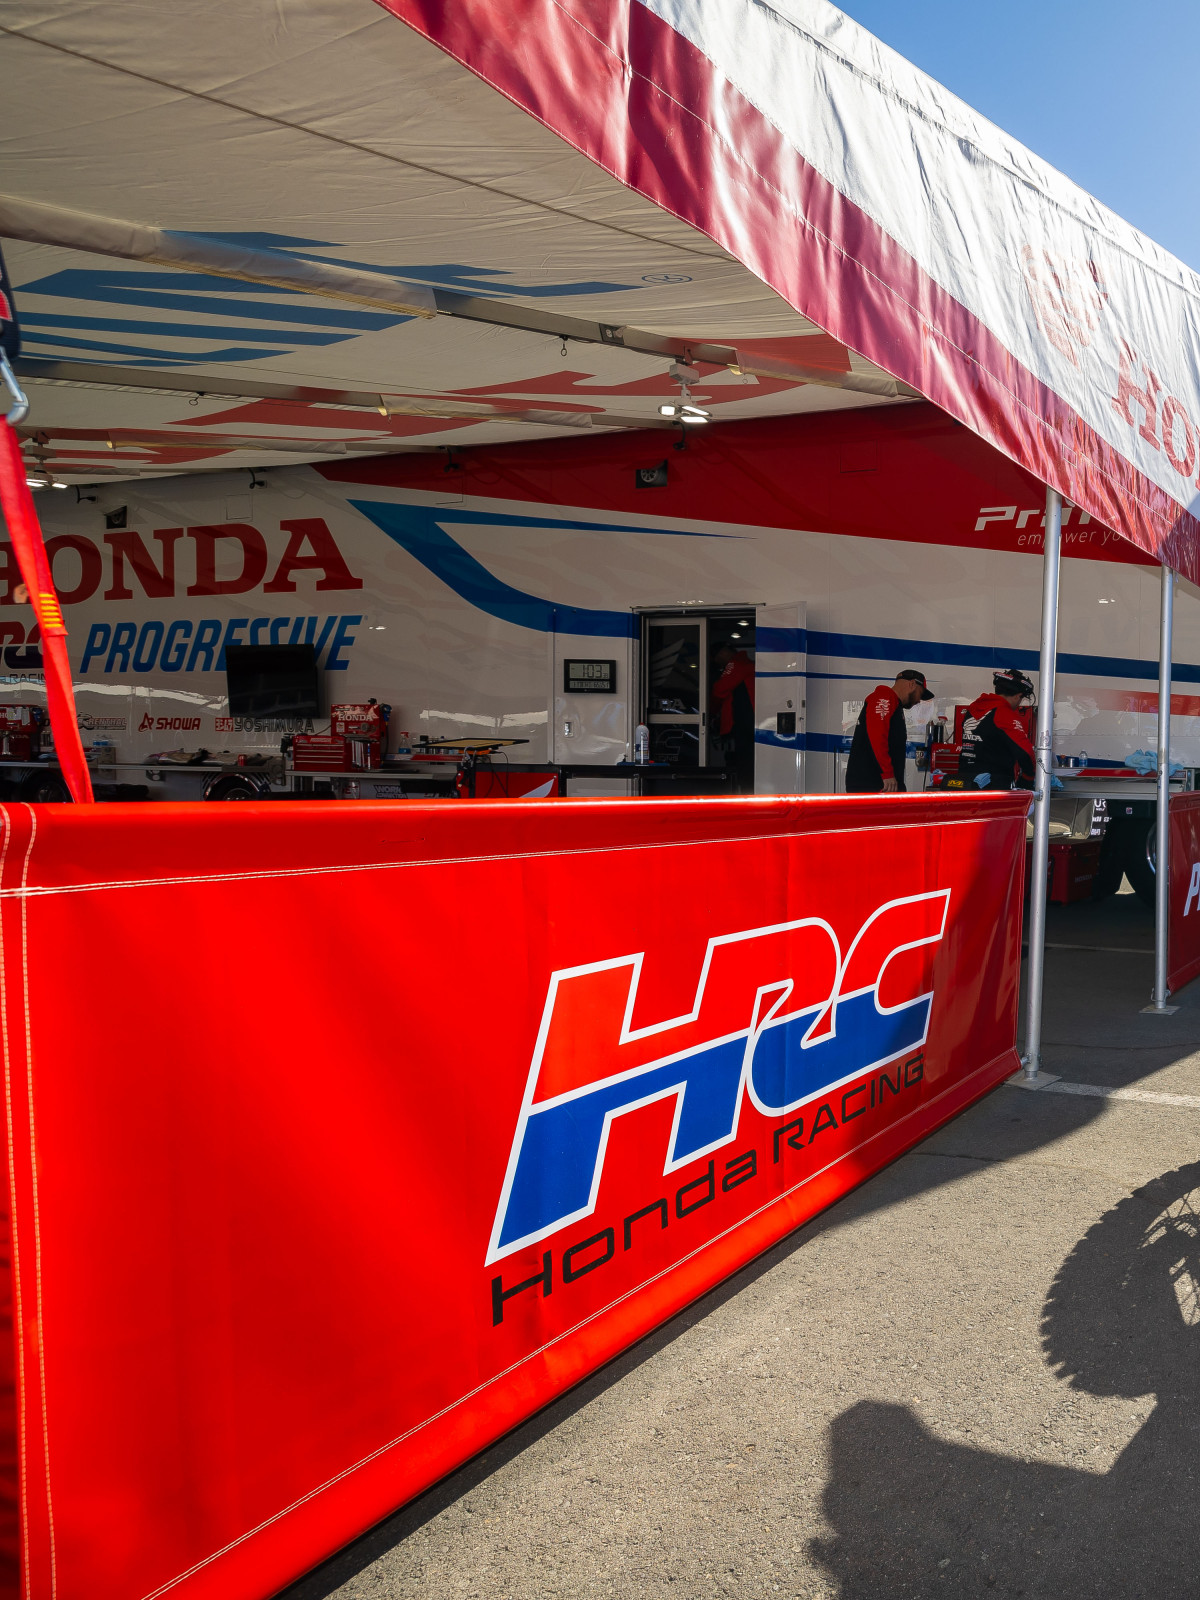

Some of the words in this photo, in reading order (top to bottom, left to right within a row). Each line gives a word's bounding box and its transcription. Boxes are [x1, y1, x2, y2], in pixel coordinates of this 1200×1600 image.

[0, 518, 363, 606] ONDA
[1017, 531, 1097, 549] emwer
[157, 718, 201, 731] SHOWA
[484, 888, 951, 1267] HRC
[491, 1149, 757, 1328] Honda
[773, 1053, 926, 1164] RACING
